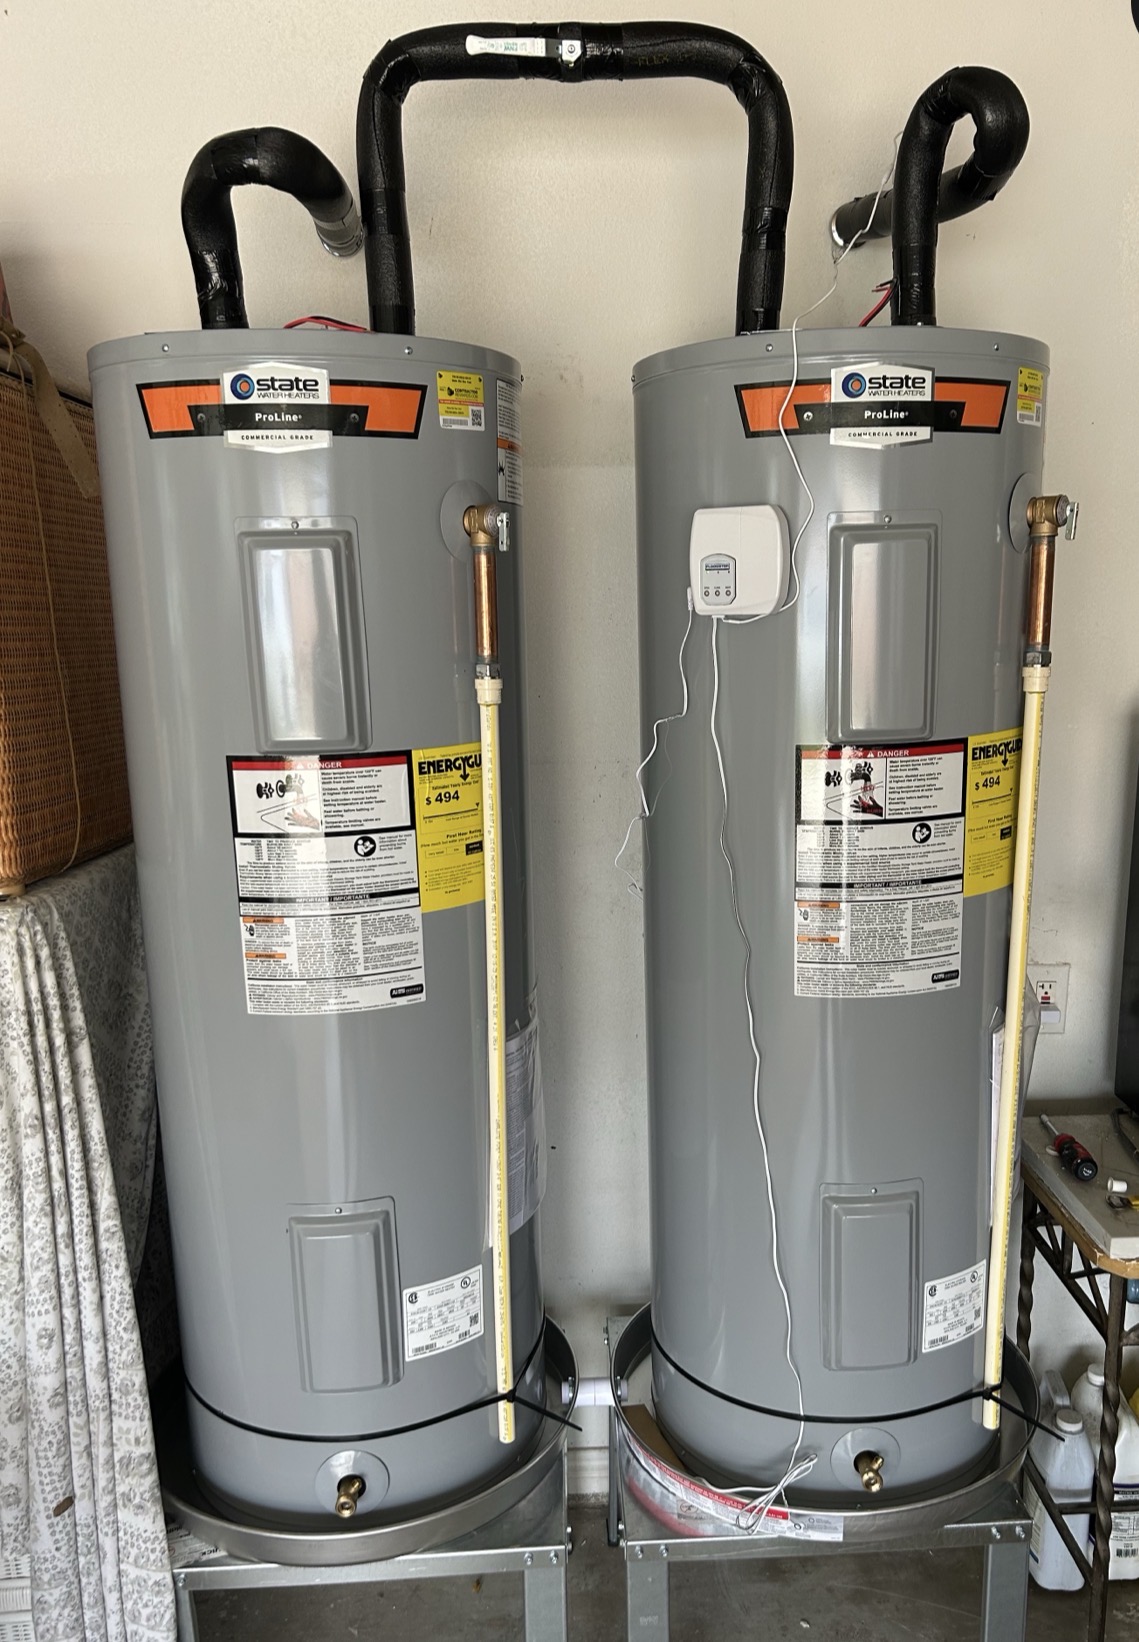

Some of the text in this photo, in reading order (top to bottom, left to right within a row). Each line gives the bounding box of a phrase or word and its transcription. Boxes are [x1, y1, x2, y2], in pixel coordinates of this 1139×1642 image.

[256, 376, 319, 392] state
[868, 375, 926, 389] state
[307, 761, 342, 769] DANGER
[975, 775, 1000, 791] $ 494
[425, 790, 460, 806] $ 494
